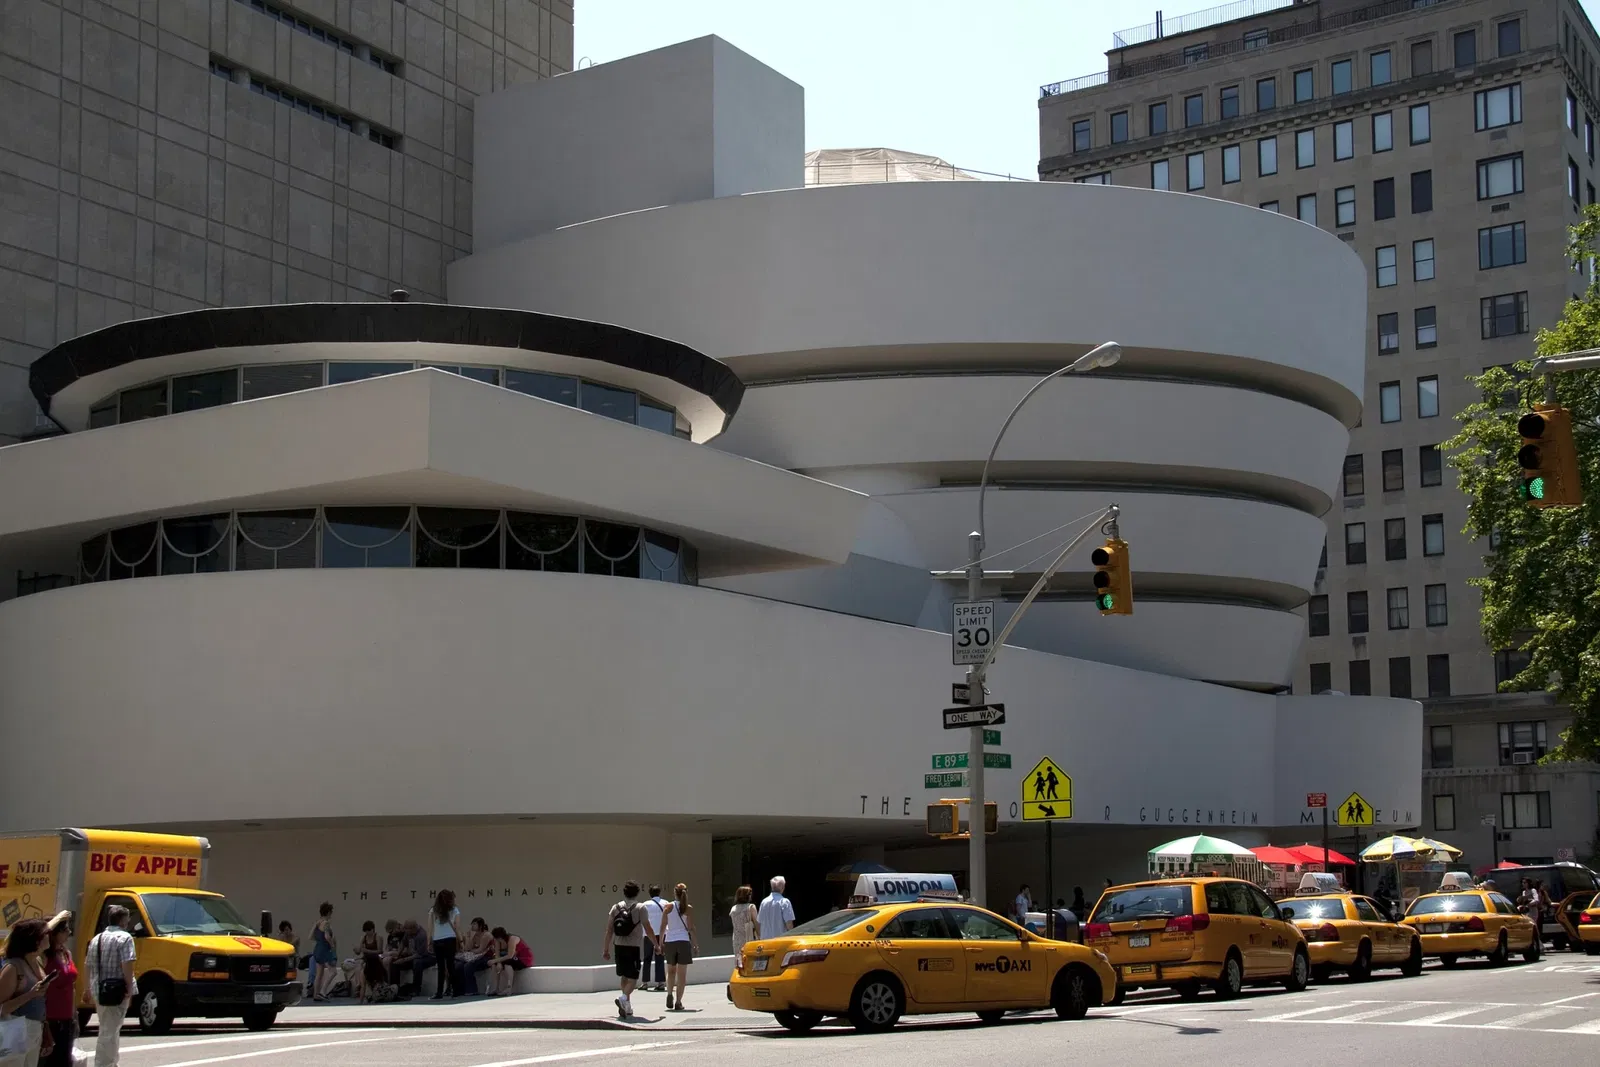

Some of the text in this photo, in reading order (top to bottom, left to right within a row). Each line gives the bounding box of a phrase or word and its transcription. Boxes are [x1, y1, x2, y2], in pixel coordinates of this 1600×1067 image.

[955, 606, 992, 616] SPEED
[958, 616, 988, 626] LIMIT
[957, 627, 990, 647] 30
[951, 710, 997, 723] ONE WAY
[935, 755, 942, 768] E
[944, 755, 957, 767] 89
[925, 773, 962, 783] FRED LEBOW
[860, 795, 1412, 824] THE R GUGGENHEIM MUEUM
[16, 860, 51, 874] Mini
[90, 852, 198, 876] BIG APPLE
[14, 875, 50, 886] Storage
[873, 880, 943, 895] LONDON
[342, 890, 388, 900] THE
[411, 885, 588, 898] THNNHAUSER
[975, 955, 1032, 973] NYC TAXI
